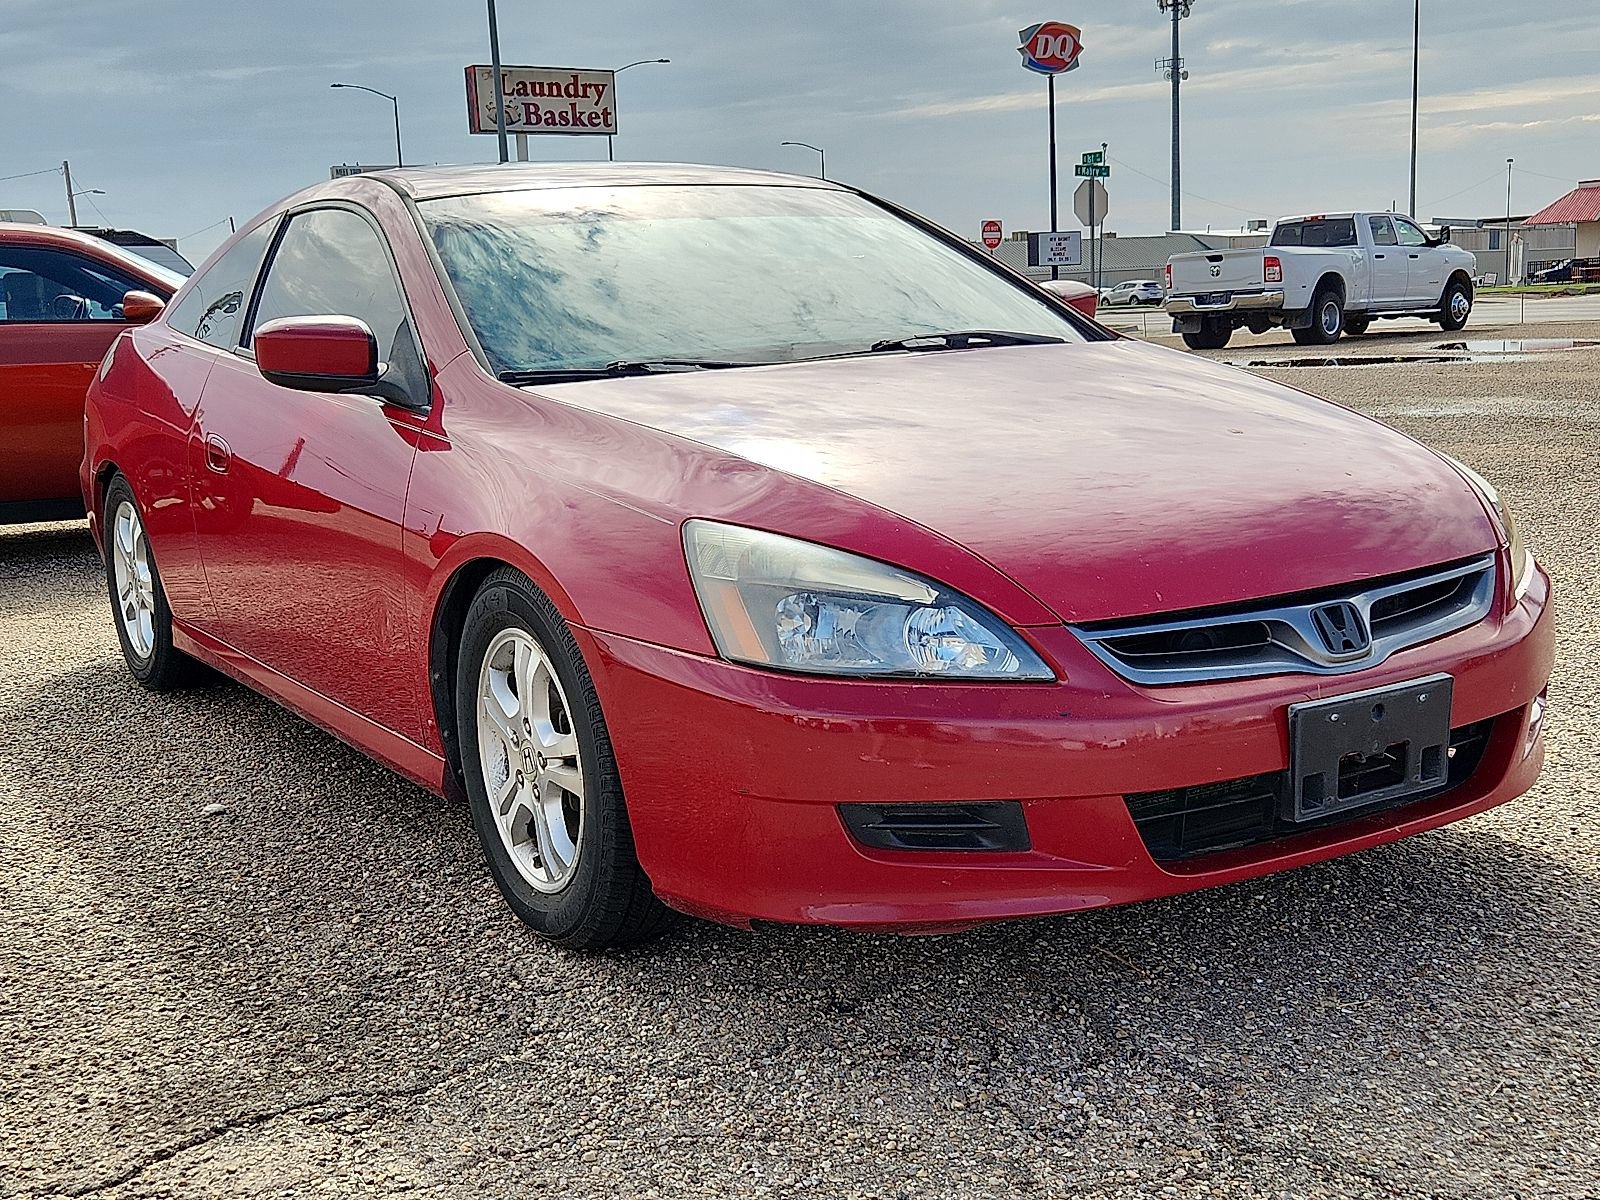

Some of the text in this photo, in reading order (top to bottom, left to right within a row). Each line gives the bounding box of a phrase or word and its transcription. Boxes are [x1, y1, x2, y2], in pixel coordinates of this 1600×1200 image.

[1035, 34, 1073, 62] DQ
[501, 73, 607, 106] Laundry
[521, 102, 612, 128] Basket
